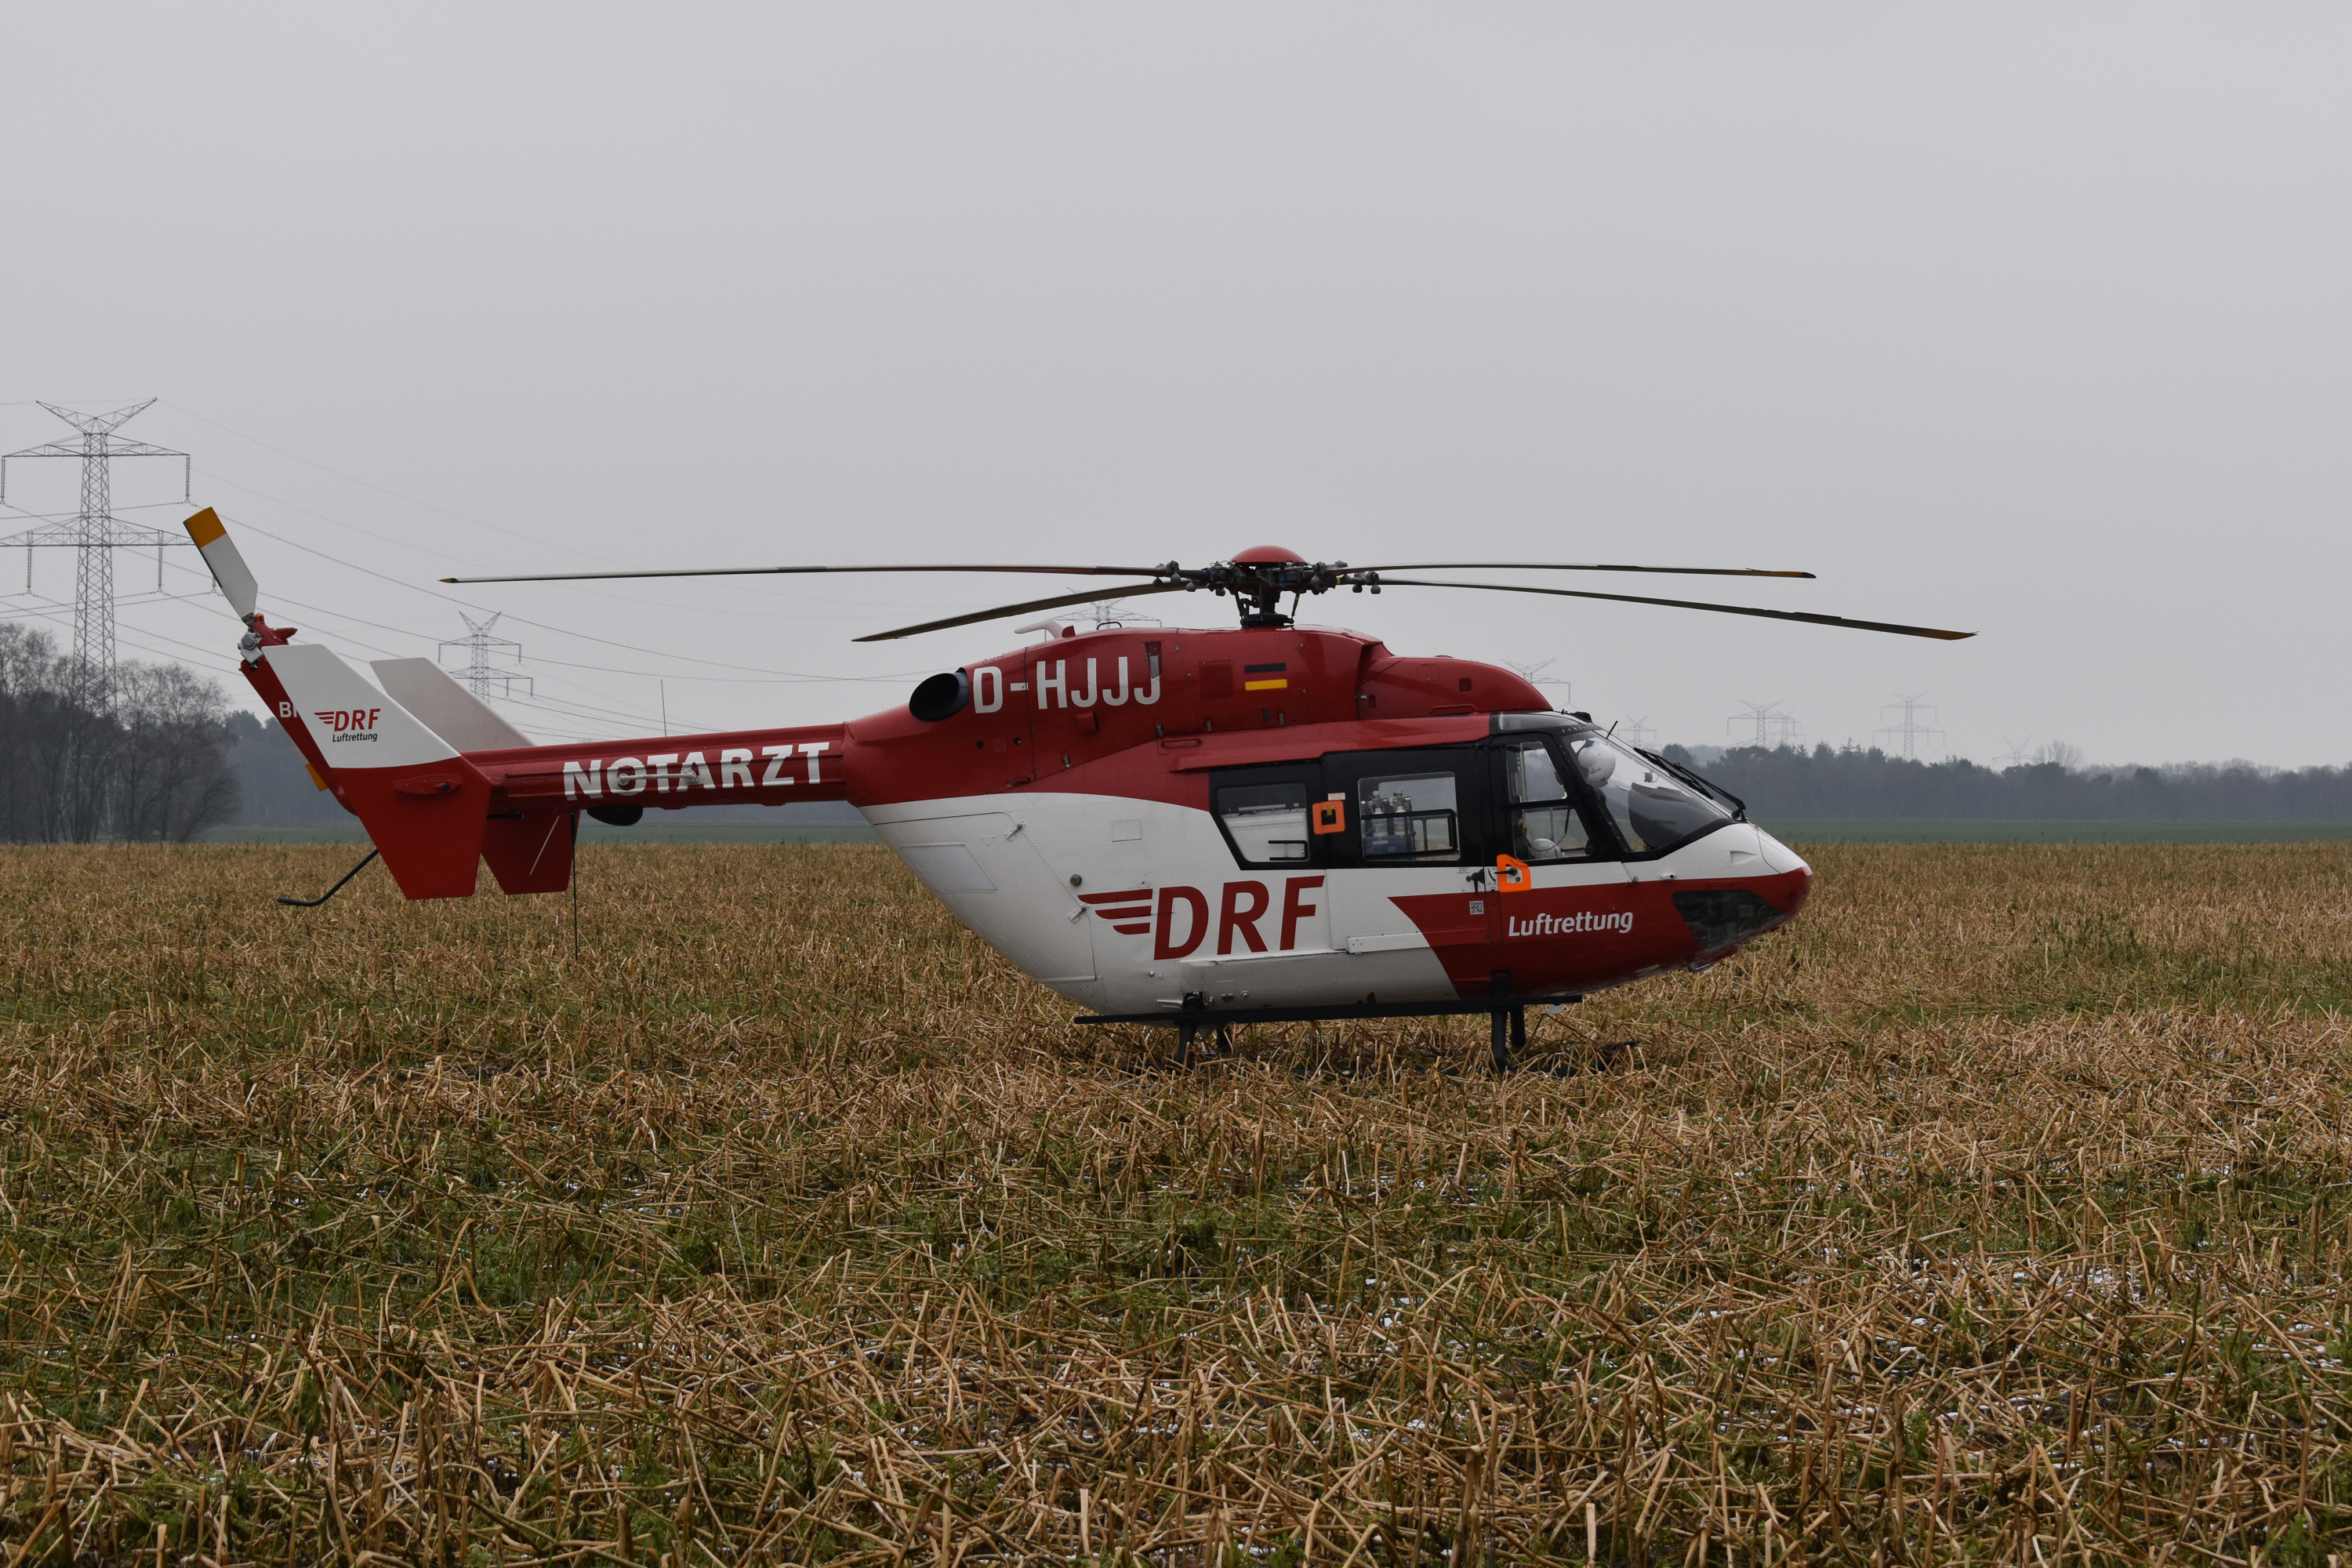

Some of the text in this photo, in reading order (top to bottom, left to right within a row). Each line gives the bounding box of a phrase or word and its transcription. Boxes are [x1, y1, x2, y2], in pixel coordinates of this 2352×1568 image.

[973, 656, 1160, 713] D-HJJJ
[332, 732, 378, 742] Luftrettung
[334, 708, 380, 731] DRF
[563, 742, 829, 800] NOTARZT
[1154, 875, 1325, 960] DRF
[1508, 911, 1633, 937] Luftrettung
